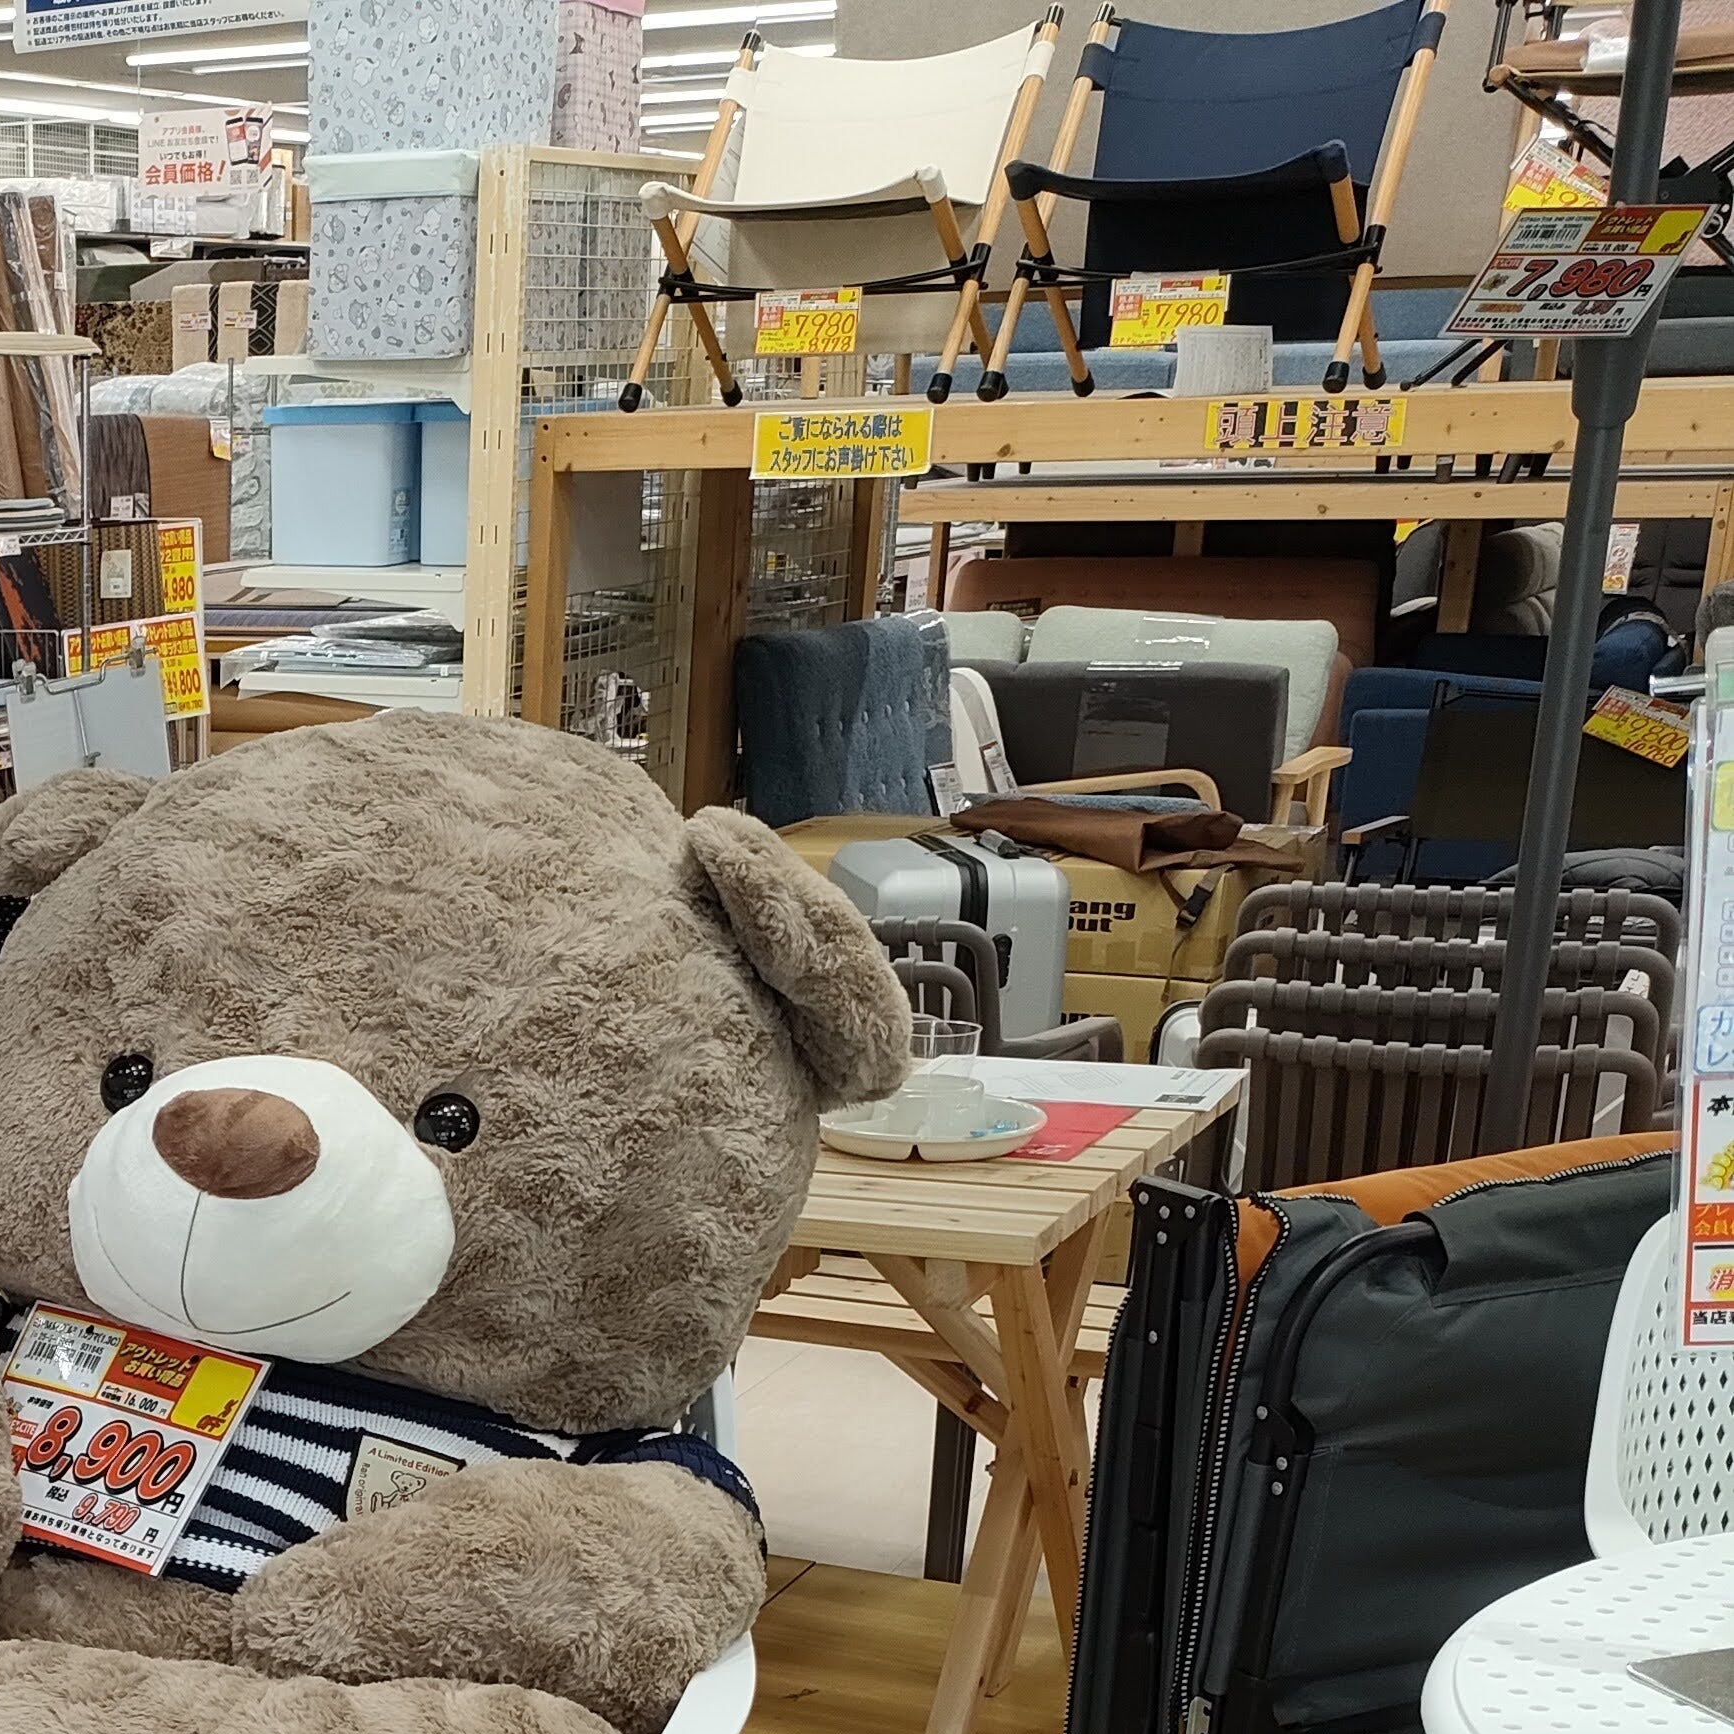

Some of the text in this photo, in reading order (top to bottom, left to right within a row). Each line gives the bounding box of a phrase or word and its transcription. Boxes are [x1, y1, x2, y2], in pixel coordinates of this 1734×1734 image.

[146, 160, 226, 186] 会員価格!
[1506, 258, 1655, 301] 7,980
[778, 414, 903, 442] ご覧になられる際は
[1216, 402, 1396, 446] 頭上注意
[770, 444, 914, 473] スタッフにお声掛け下さい
[1069, 900, 1136, 921] ang
[119, 1341, 193, 1373] アウトレット
[123, 1359, 187, 1389] お買い得品
[26, 1405, 197, 1515] 8,900 円
[377, 1449, 414, 1470] Limited
[45, 1484, 160, 1544] 税込 9,790 円
